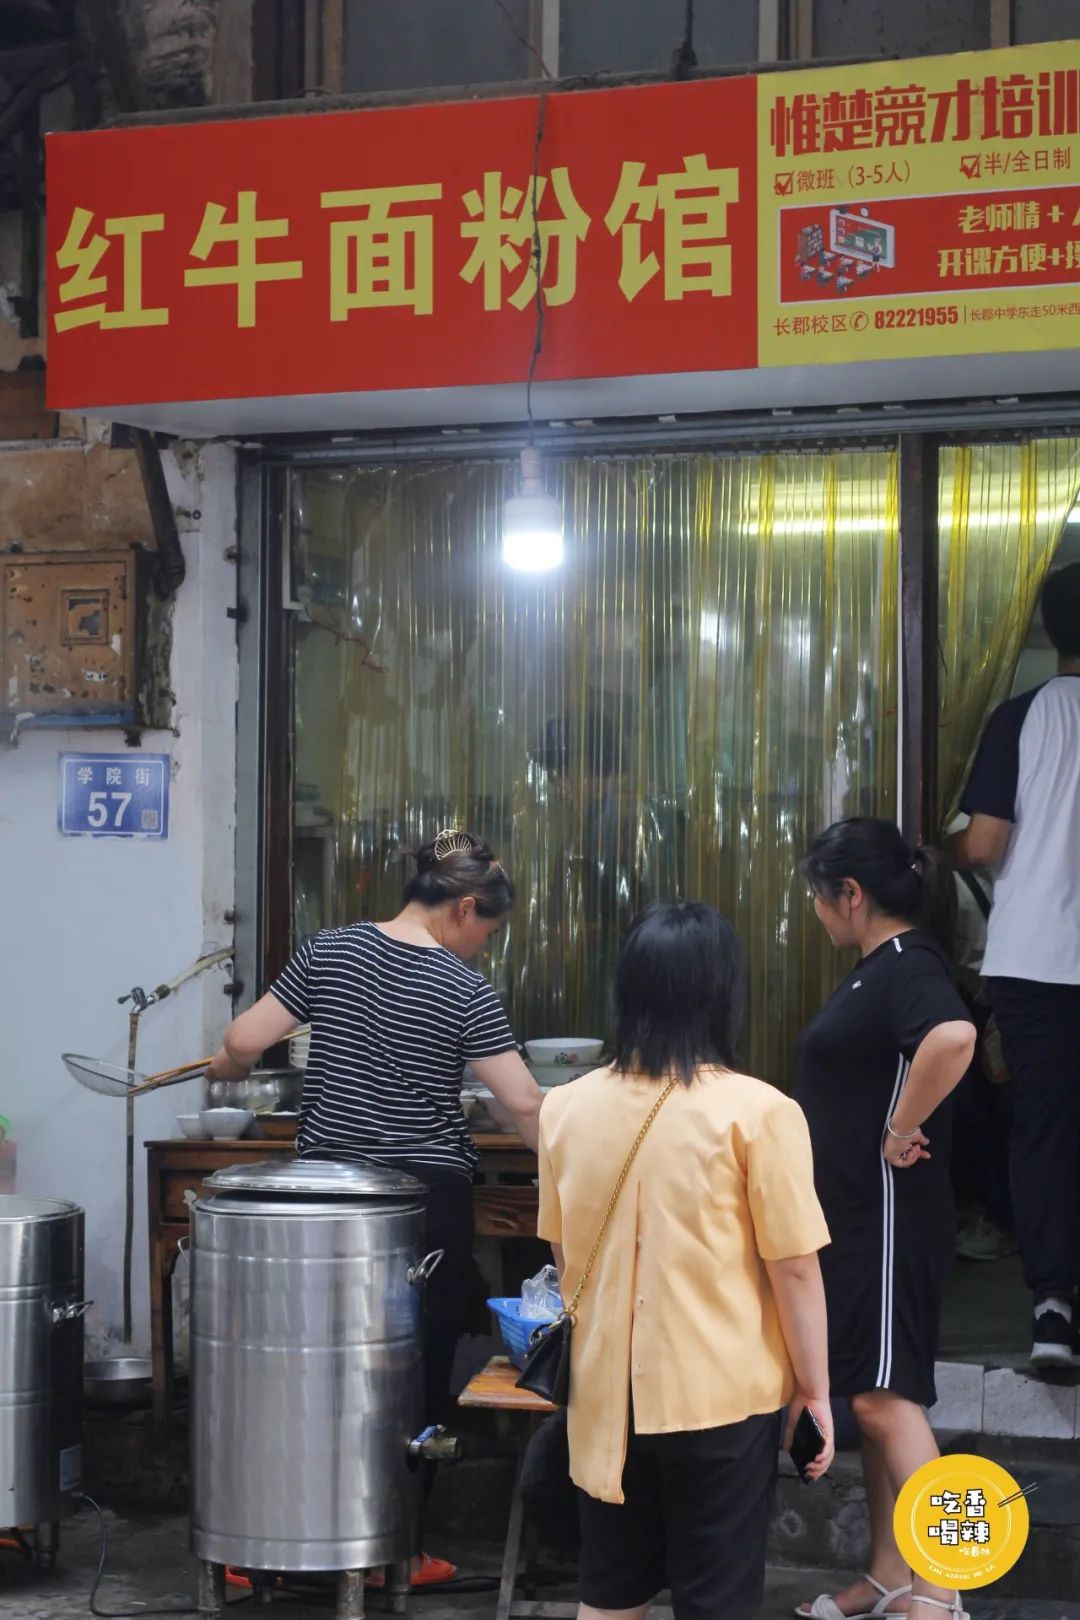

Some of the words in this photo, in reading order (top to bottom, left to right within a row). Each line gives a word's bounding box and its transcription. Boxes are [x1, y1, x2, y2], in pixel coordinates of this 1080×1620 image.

[983, 147, 1071, 175] 半/全日制
[54, 153, 740, 333] 红牛面粉馆
[773, 315, 848, 336] 长郡校区
[874, 306, 959, 329] 82221955
[77, 766, 150, 785] 学院街
[87, 791, 132, 827] 57
